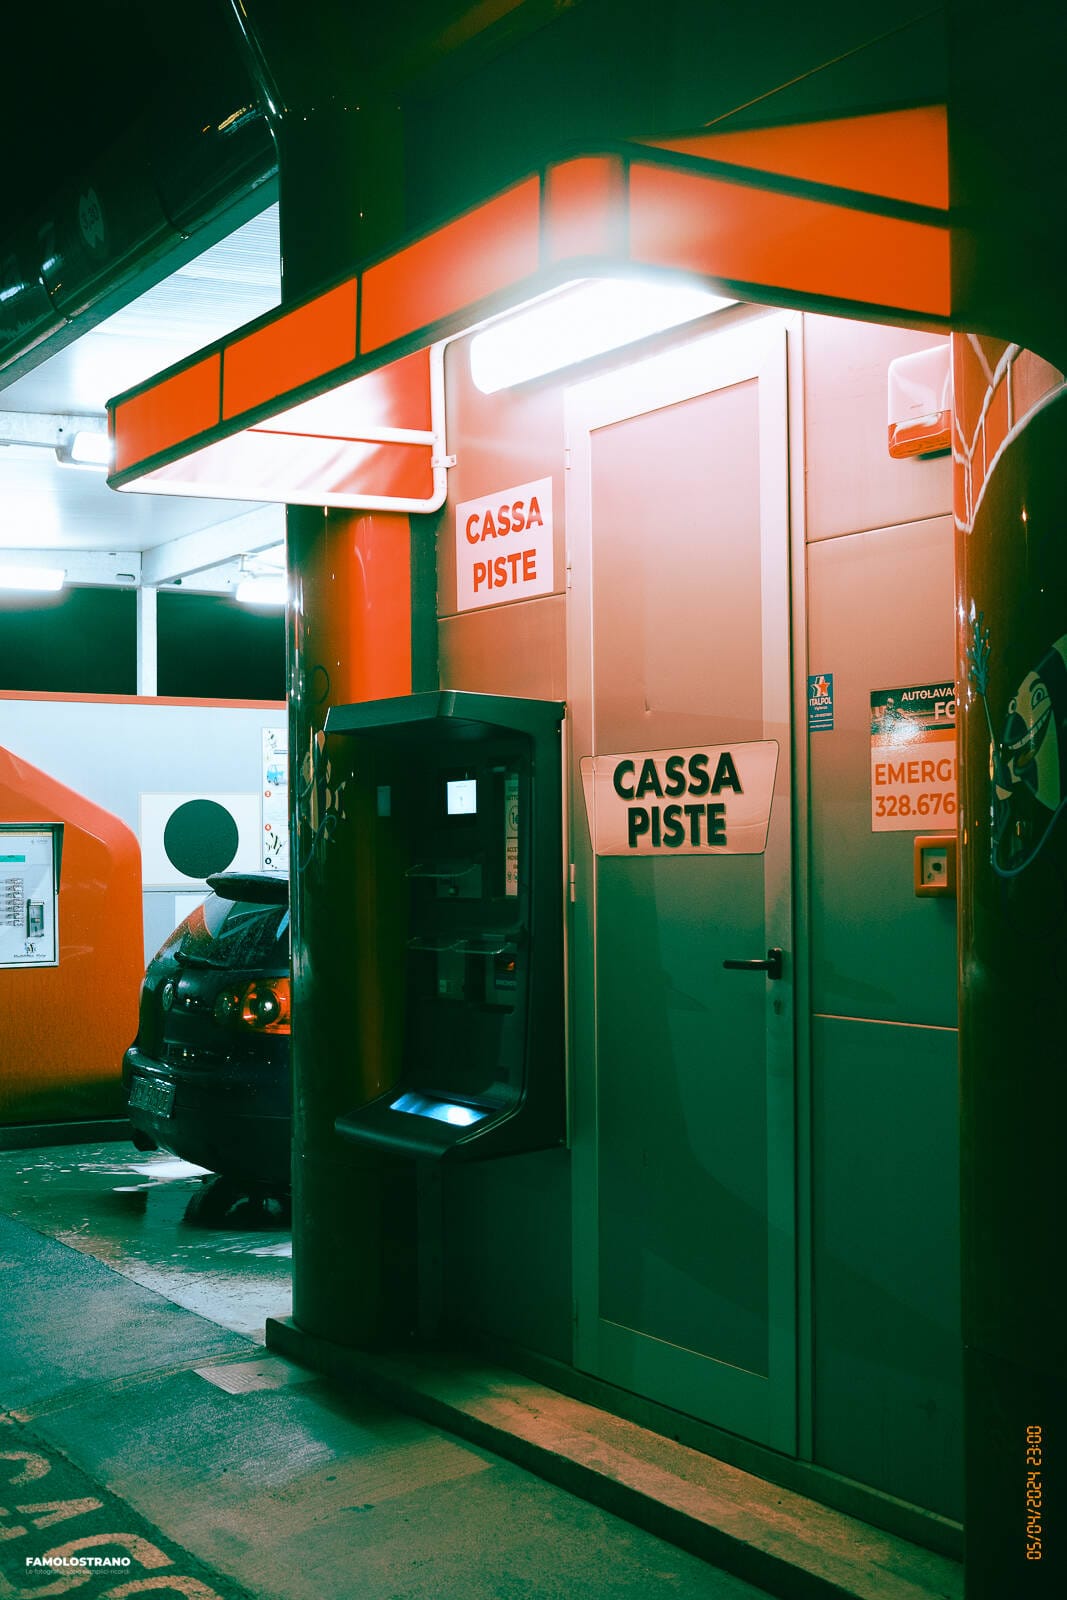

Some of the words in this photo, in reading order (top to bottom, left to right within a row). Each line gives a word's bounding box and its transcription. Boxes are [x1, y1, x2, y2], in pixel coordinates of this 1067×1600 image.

[465, 496, 544, 545] CASSA
[473, 548, 537, 592] PISTE
[809, 696, 832, 706] ITALPOL
[613, 752, 744, 801] CASSA
[875, 758, 958, 785] EMERG
[628, 803, 728, 848] PISTE
[875, 792, 956, 817] 328.676
